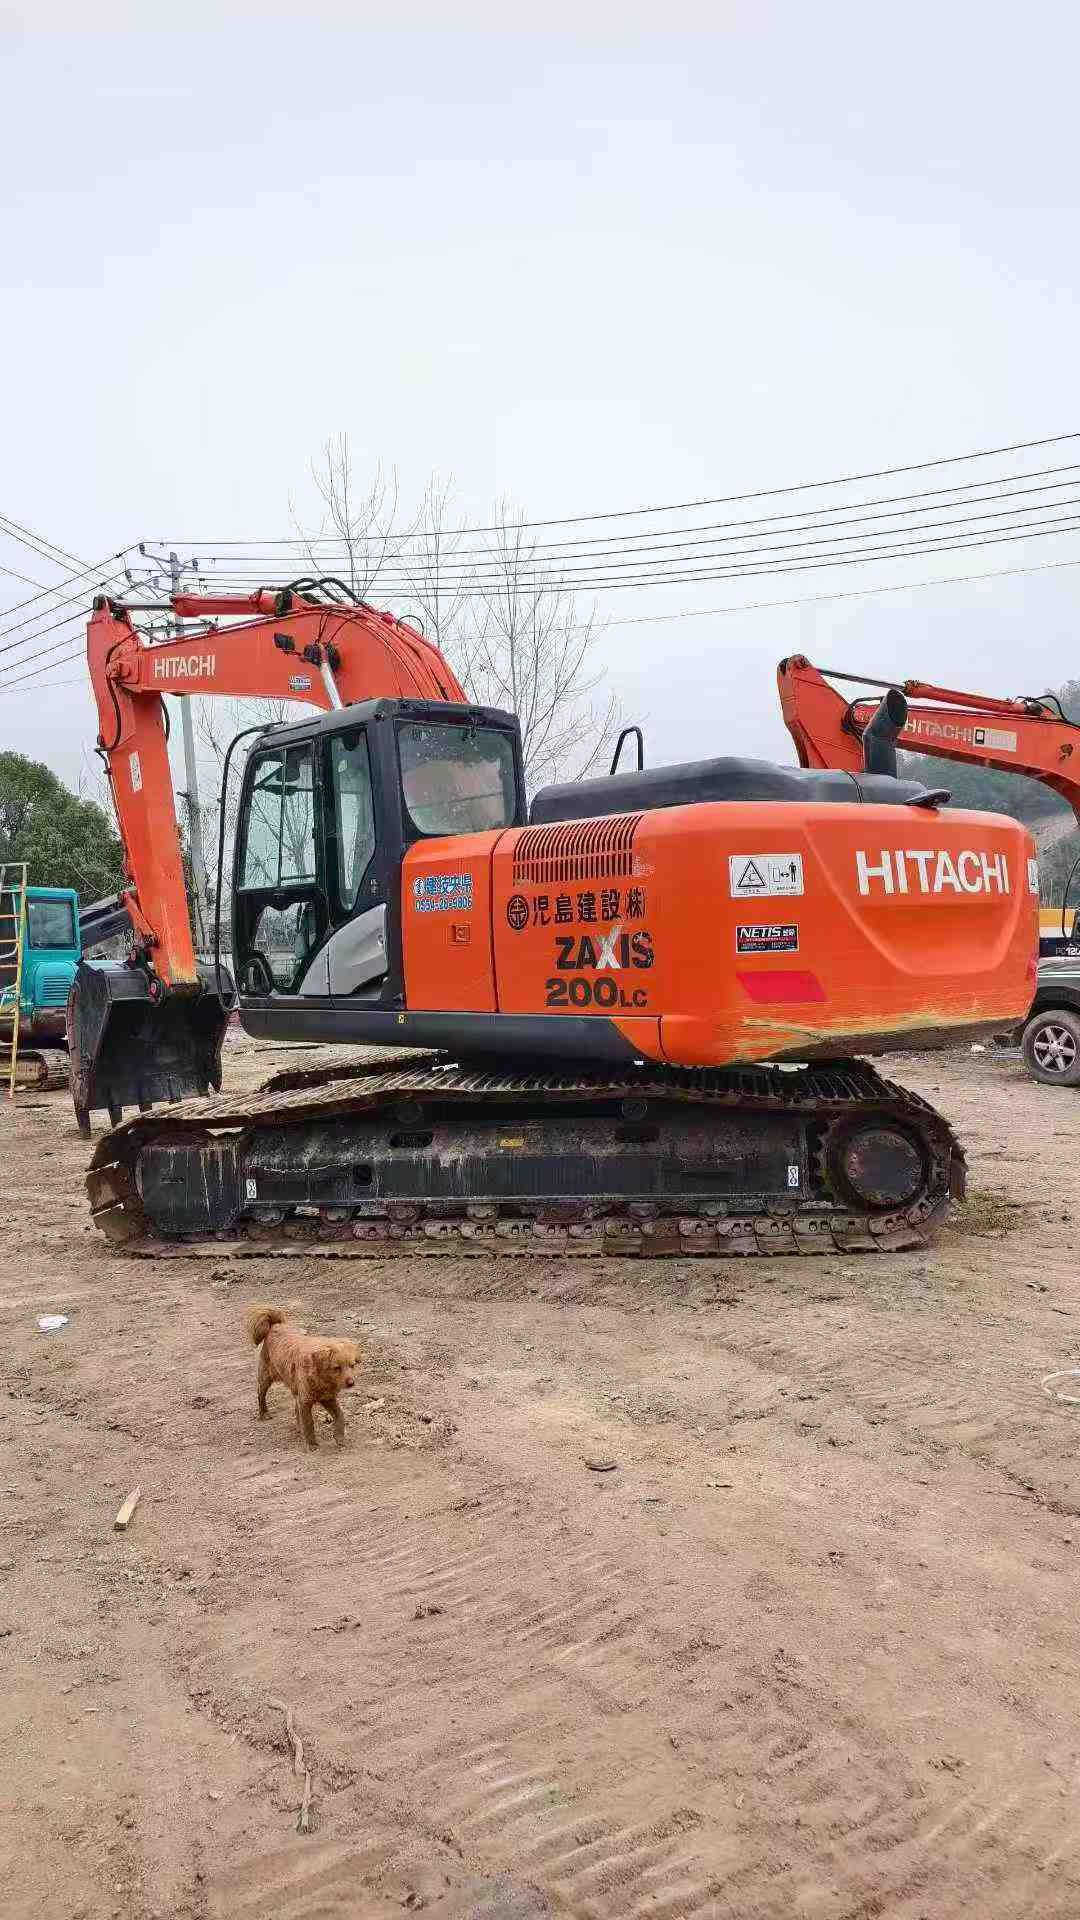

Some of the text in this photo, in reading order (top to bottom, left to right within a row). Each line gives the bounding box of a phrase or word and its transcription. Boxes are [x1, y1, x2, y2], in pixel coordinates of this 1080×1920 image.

[154, 654, 215, 678] HITACHI
[904, 715, 972, 741] HITACHI
[855, 850, 1010, 895] HITACHI
[740, 926, 782, 938] NETIS
[555, 928, 655, 970] ZAXIS
[545, 977, 648, 1008] 200LC
